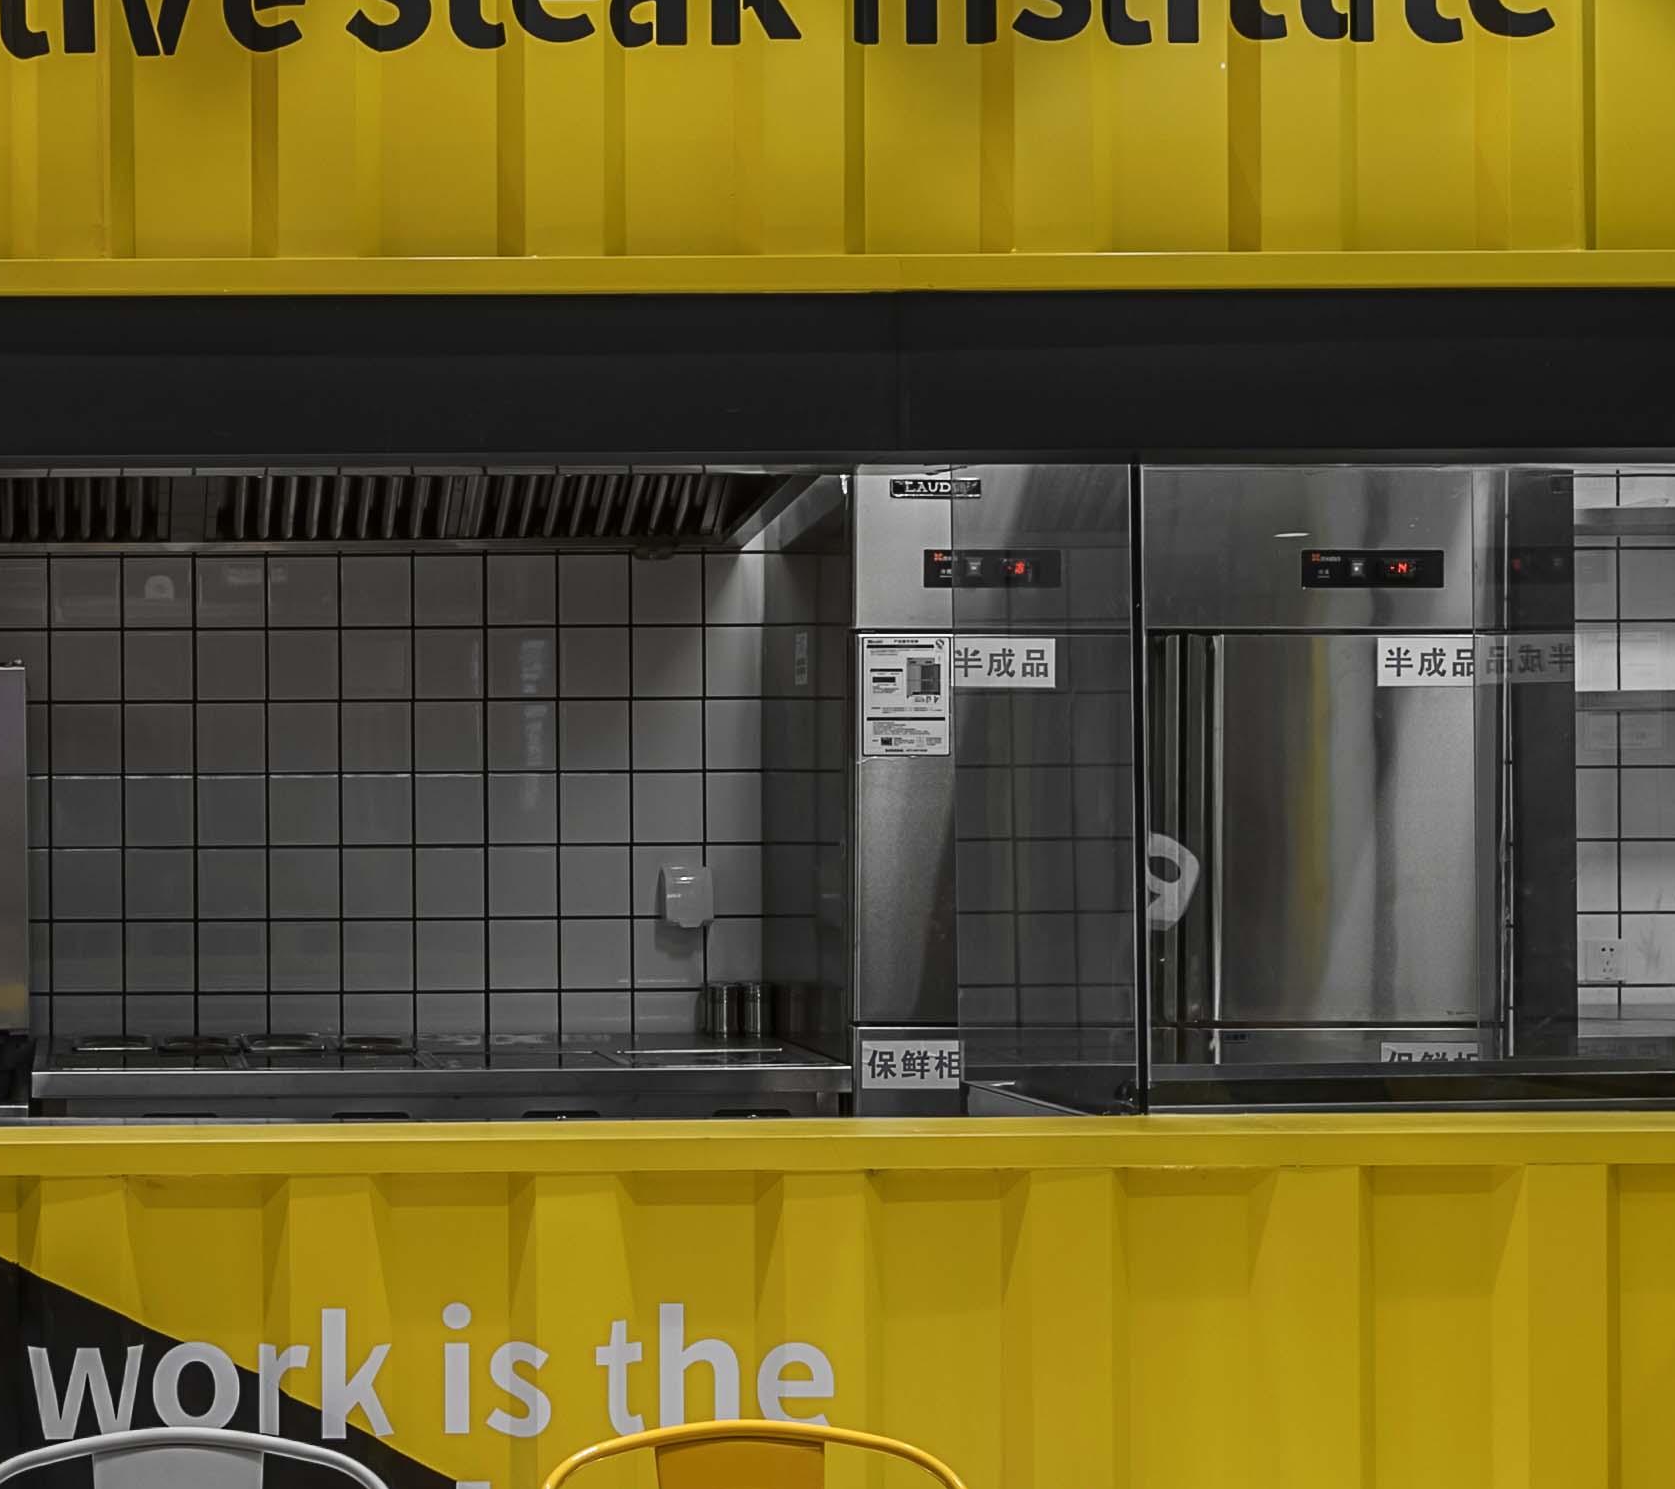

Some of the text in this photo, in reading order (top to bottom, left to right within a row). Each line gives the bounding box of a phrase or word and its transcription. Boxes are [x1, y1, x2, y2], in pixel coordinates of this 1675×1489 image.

[953, 647, 1049, 678] 半成品
[1384, 646, 1475, 678] 半成品
[867, 1049, 960, 1079] 保鲜柜
[27, 1309, 393, 1443] work
[443, 1303, 551, 1437] is
[596, 1303, 835, 1436] the
